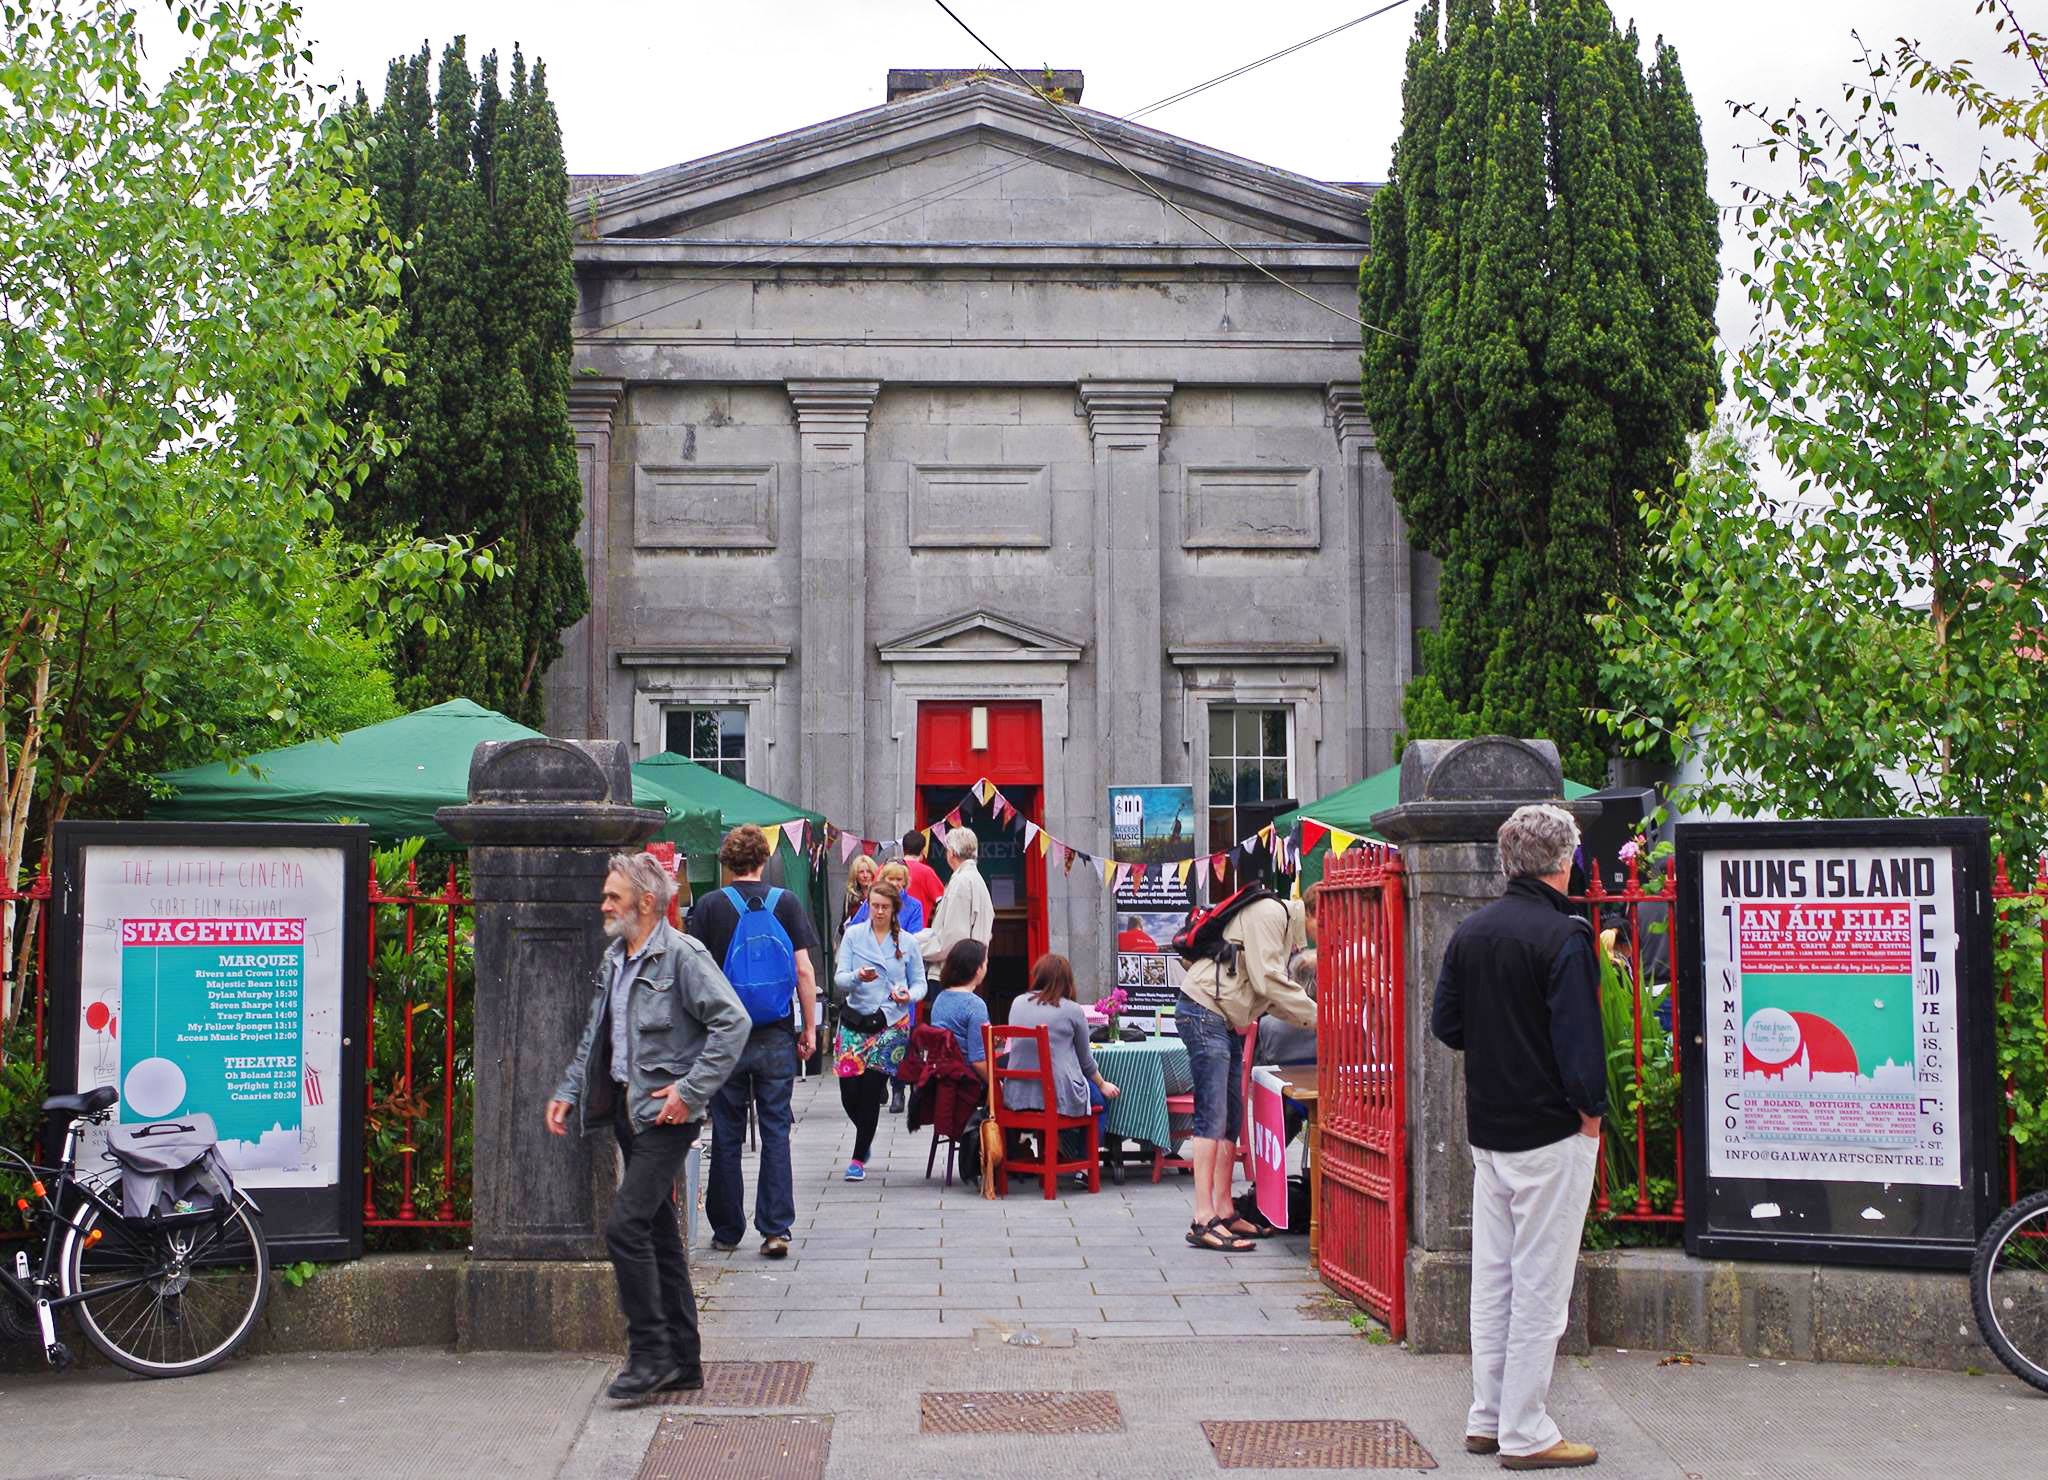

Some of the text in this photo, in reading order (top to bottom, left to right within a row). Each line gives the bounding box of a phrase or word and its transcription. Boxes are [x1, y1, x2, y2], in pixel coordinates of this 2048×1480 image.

[930, 841, 1020, 858] MKET
[122, 860, 304, 889] THE LITTLE CINEMA
[1720, 857, 1936, 898] NUNS ISLAND
[151, 898, 284, 917] SHORT FILM FESTIVAL
[1741, 904, 1910, 930] AN ÁIT EILE
[123, 921, 303, 942] STAGETIMES
[1741, 930, 1910, 942] THAT'S HOW IT STARTS
[219, 954, 298, 968] MARQUEE
[195, 970, 225, 978] Rivers
[275, 969, 298, 977] 17:00
[206, 980, 246, 990] Majestic
[208, 991, 235, 1000] Dylan
[237, 991, 273, 1000] Murphy
[210, 1001, 240, 1010] Steven
[241, 1001, 272, 1010] Sharpe
[217, 1012, 243, 1021] Tracy
[187, 1023, 203, 1032] My
[205, 1022, 234, 1030] Fellow
[236, 1022, 272, 1032] Sponges
[1752, 1020, 1793, 1035] Free from
[177, 1034, 208, 1042] Access
[240, 1032, 272, 1042] Project
[224, 1056, 297, 1068] THEATRE
[227, 1082, 270, 1091] Boyfights
[231, 1092, 272, 1100] Canaries
[1764, 1100, 1804, 1108] BOLAND,
[1809, 1102, 1864, 1110] BOYFIGHTS,
[1256, 1120, 1281, 1170] NFO
[1725, 1150, 1944, 1167] INFO@GALWAYARTSCENTRE.IE
